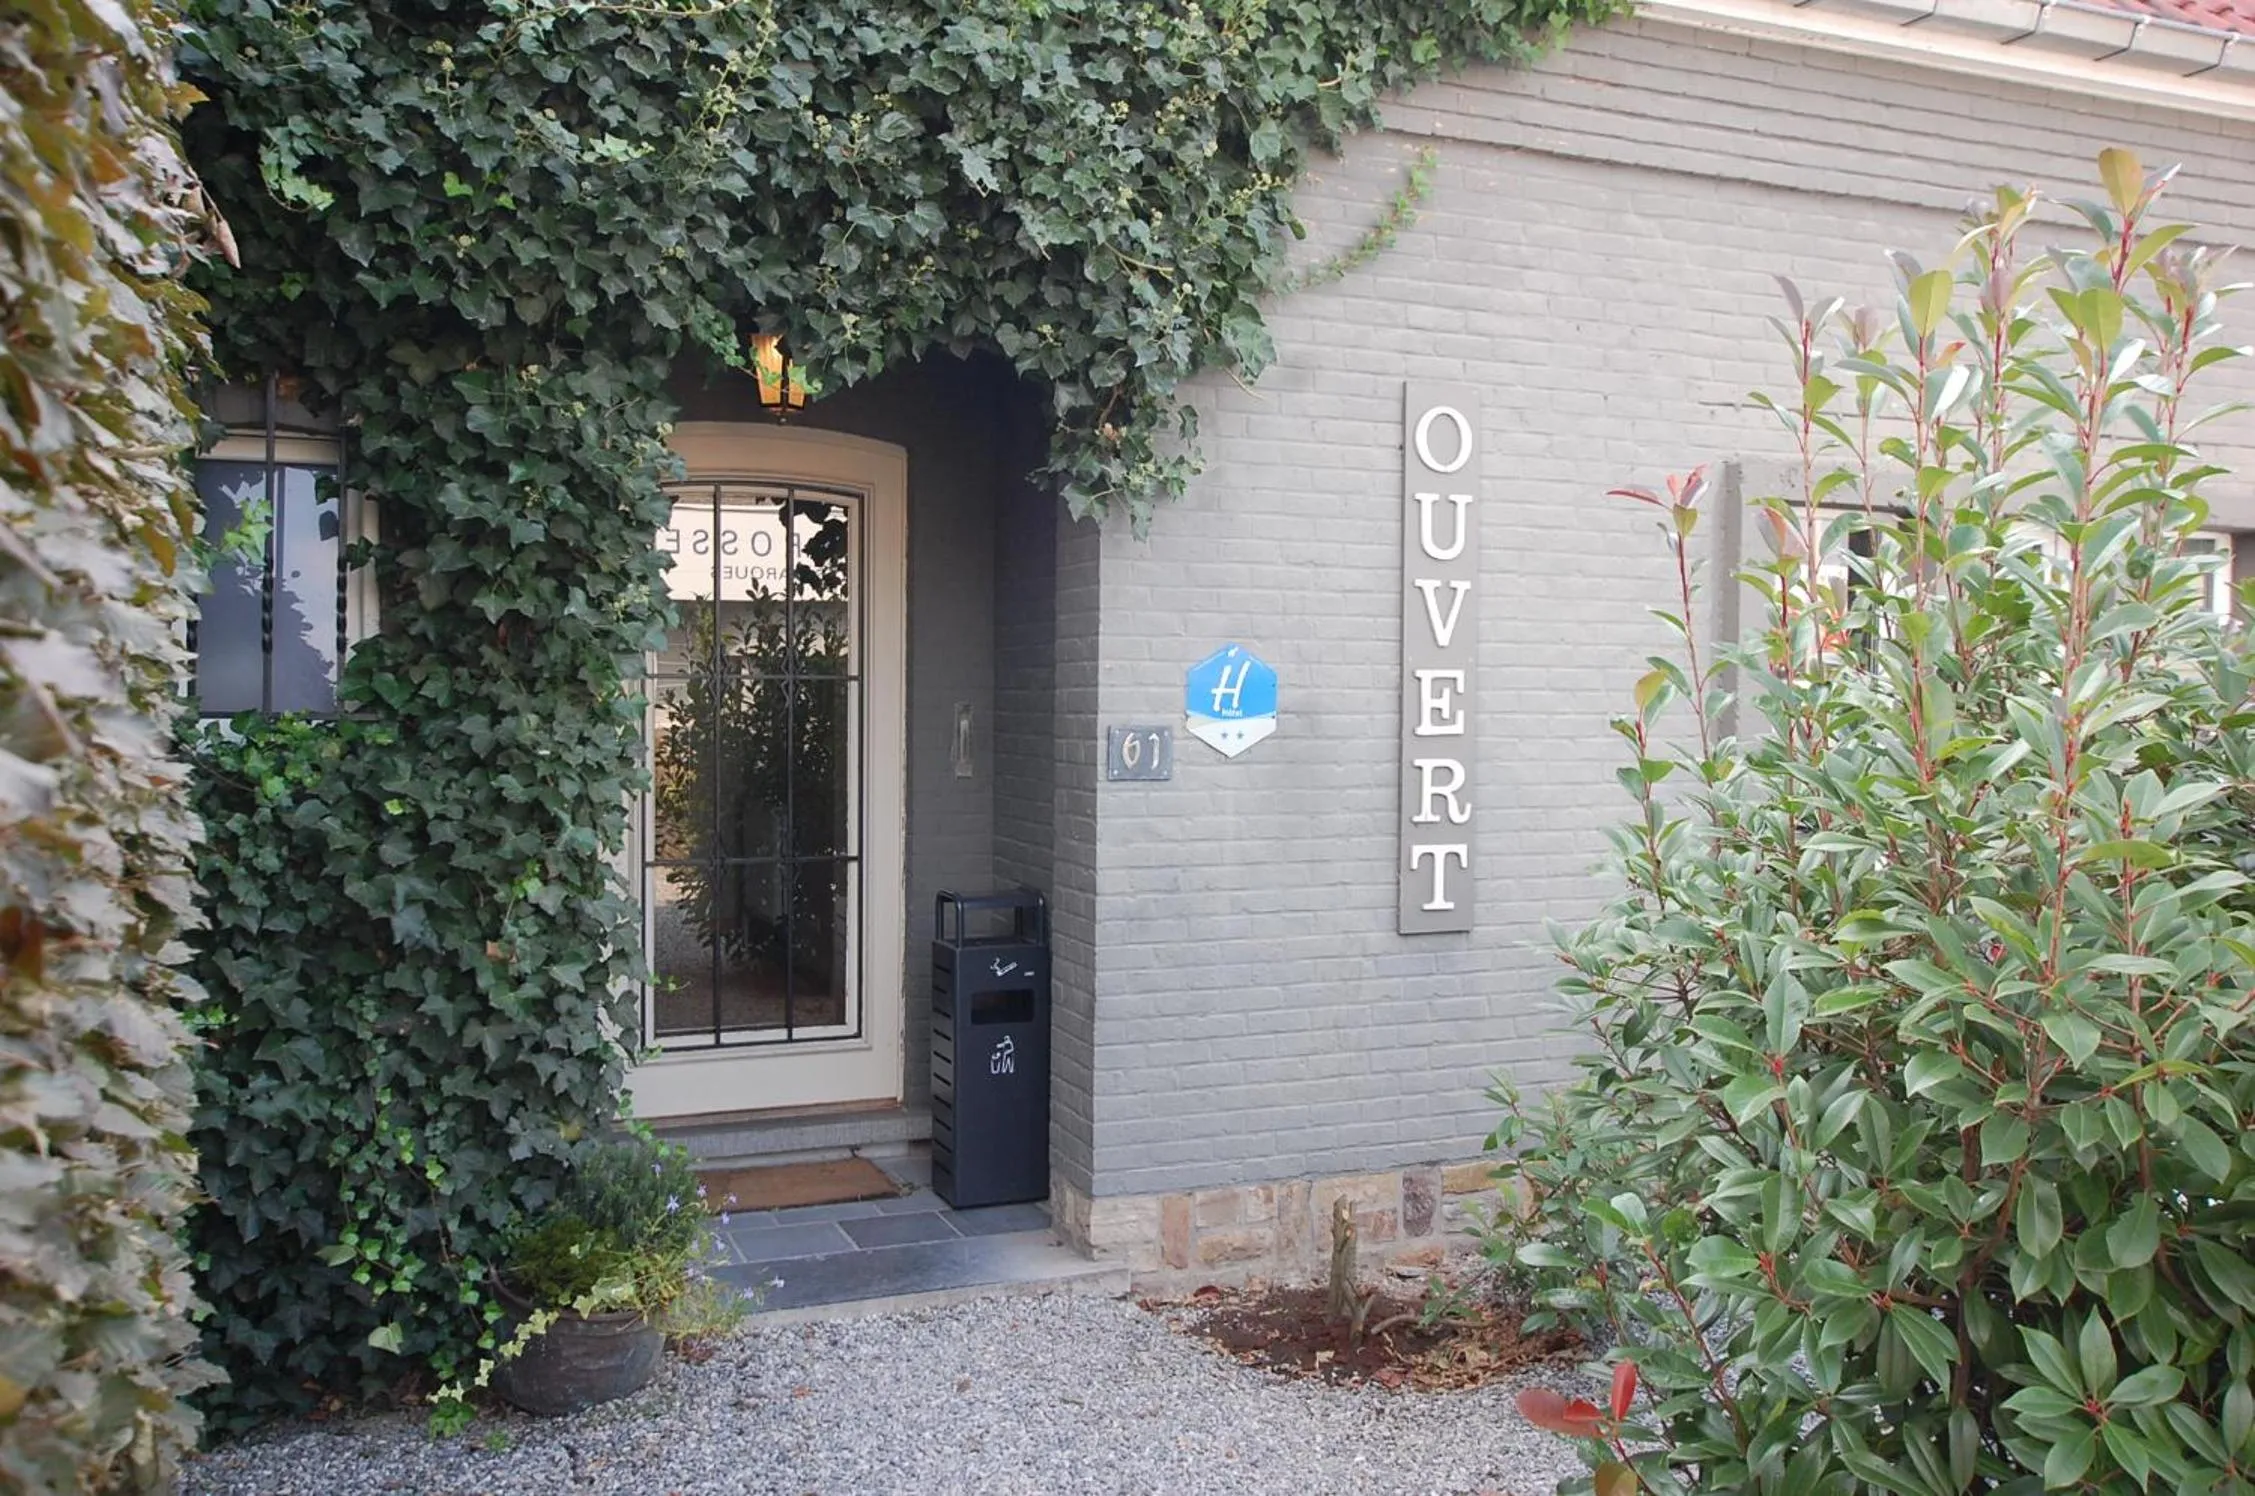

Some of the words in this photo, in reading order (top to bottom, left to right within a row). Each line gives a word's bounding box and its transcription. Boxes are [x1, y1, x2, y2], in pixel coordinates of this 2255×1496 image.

[1410, 404, 1473, 911] OUVERT
[1211, 660, 1251, 711] H
[1121, 731, 1161, 771] 61
